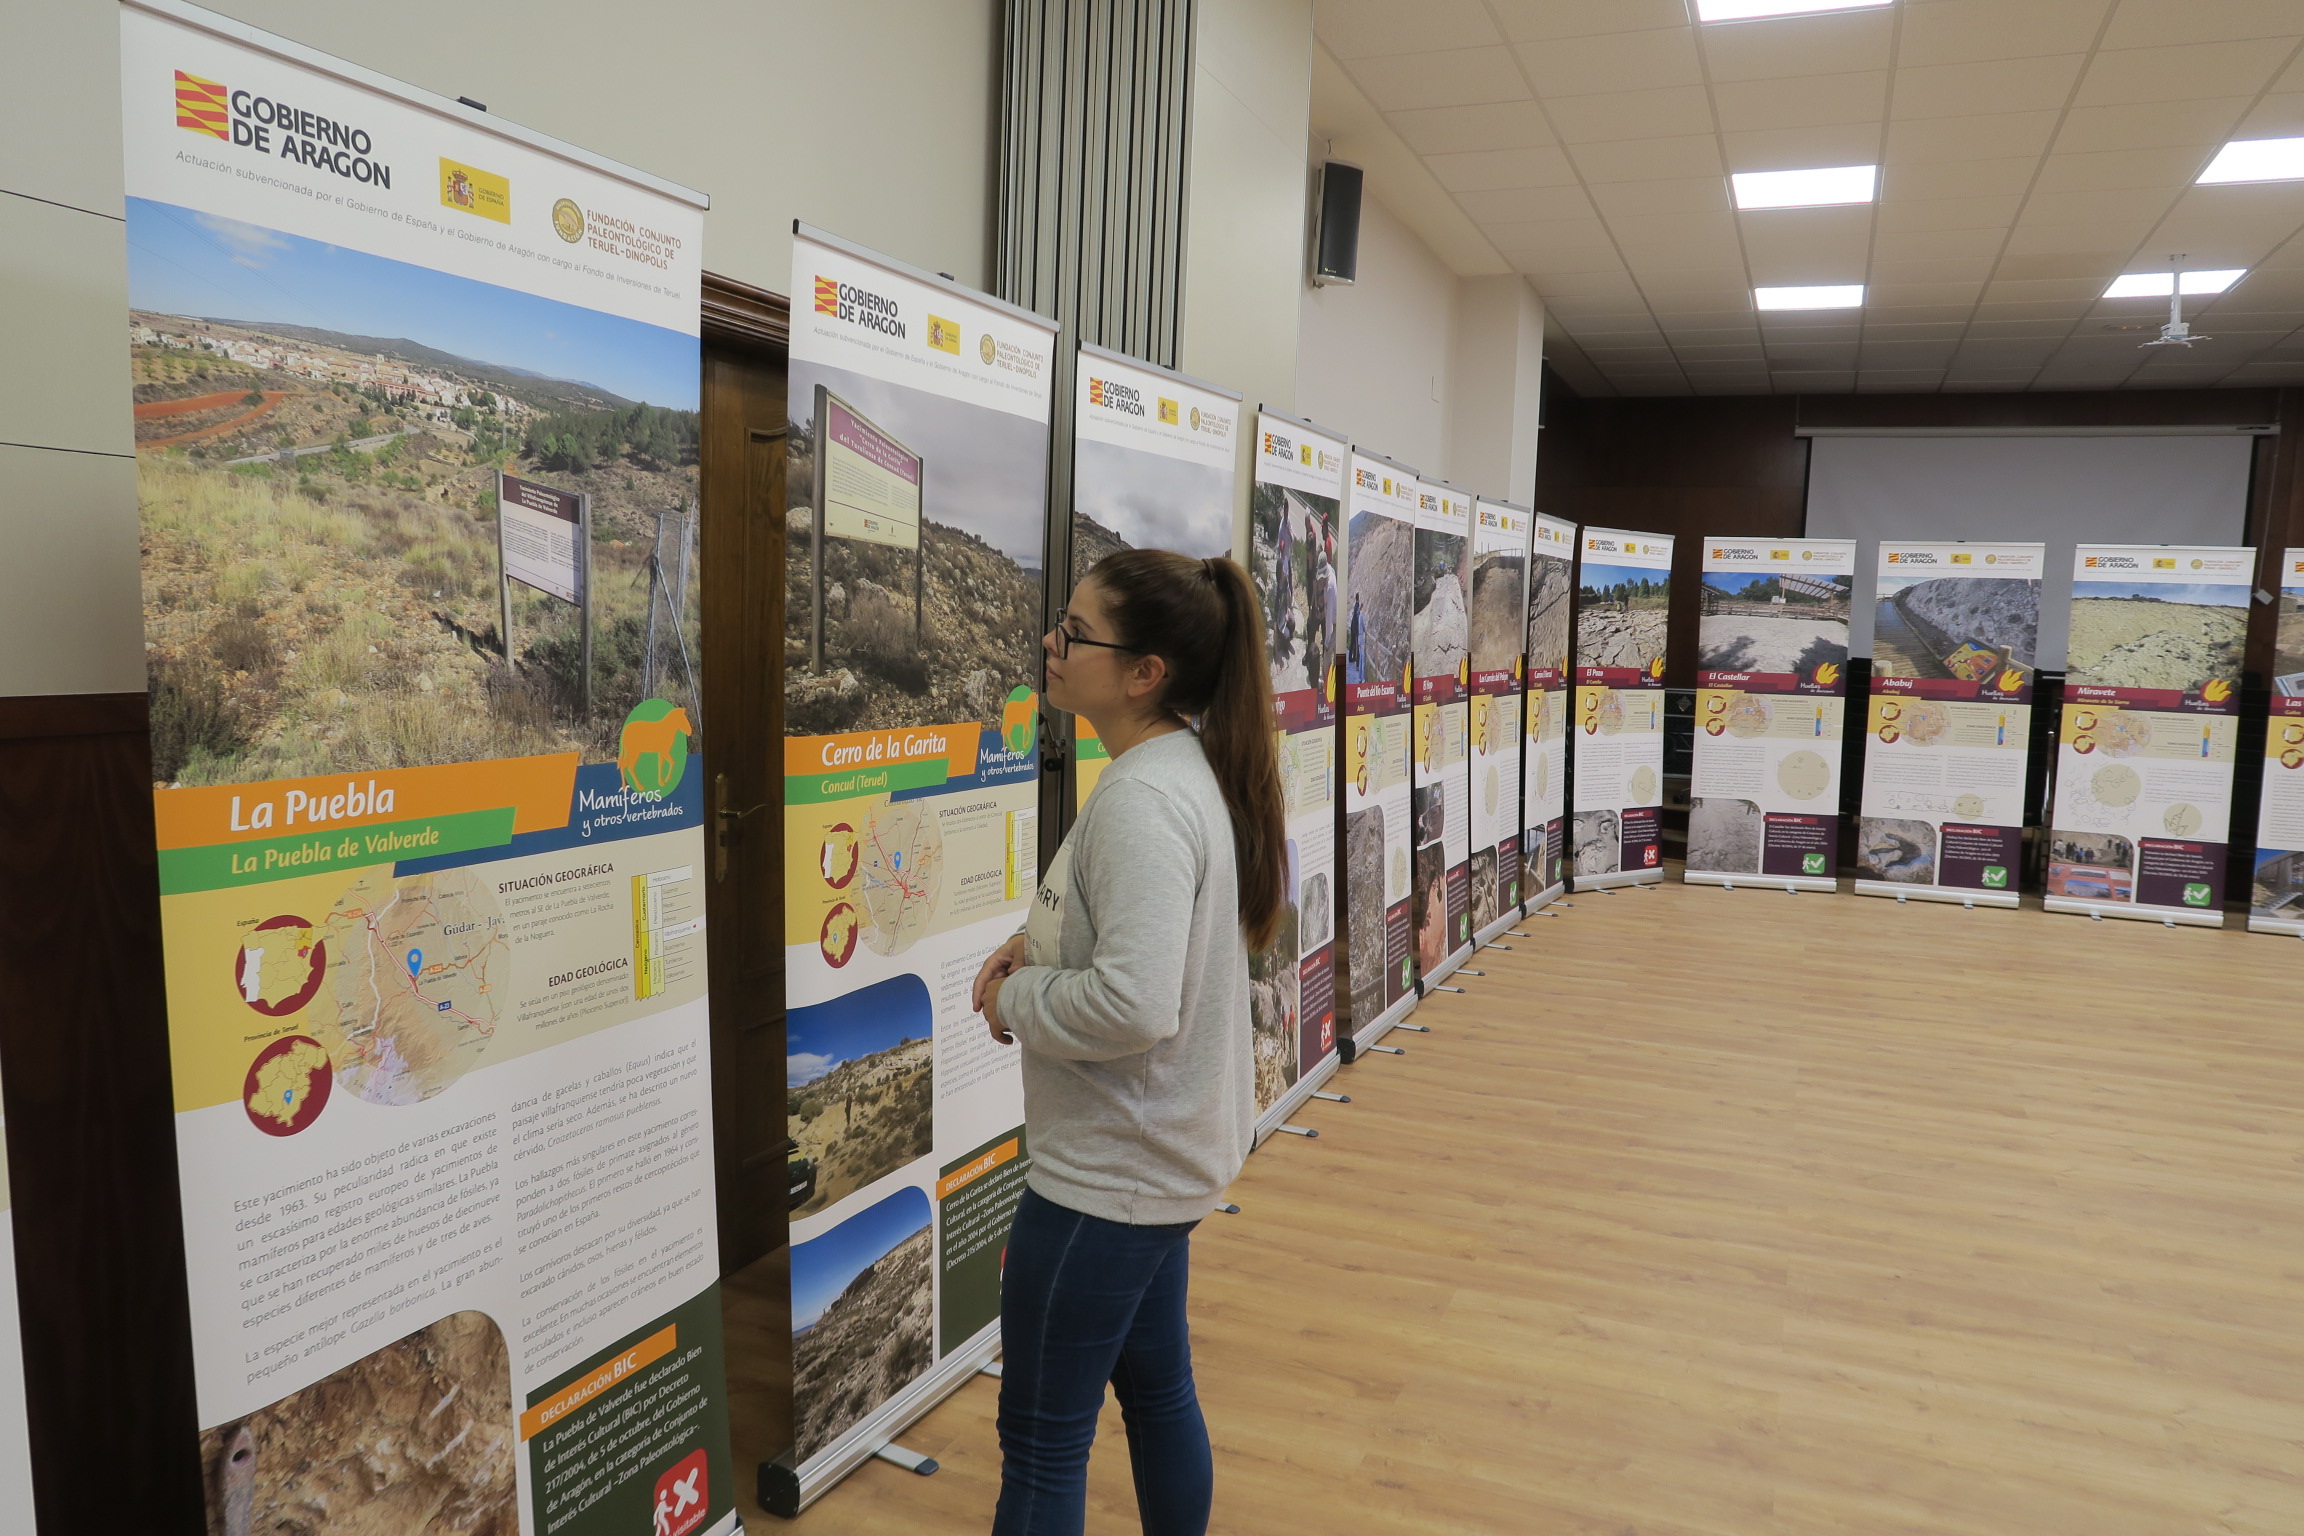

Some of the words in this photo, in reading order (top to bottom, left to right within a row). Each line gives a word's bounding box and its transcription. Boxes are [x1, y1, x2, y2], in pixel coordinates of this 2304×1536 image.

[231, 90, 372, 155] GOBIERNO
[232, 118, 270, 154] DE
[280, 134, 390, 190] ARAGON
[478, 187, 504, 200] GOBIERNO
[478, 192, 486, 201] DE
[485, 194, 504, 207] ESPAÑA
[175, 151, 232, 174] Actuación
[235, 168, 313, 197] subvencionada
[315, 191, 332, 202] por
[334, 196, 344, 205] el
[346, 198, 389, 218] Gobierno
[391, 211, 403, 222] de
[405, 214, 437, 231] España
[439, 226, 445, 235] y
[447, 228, 455, 236] el
[457, 229, 494, 247] Gobierno
[496, 241, 506, 251] de
[508, 244, 535, 258] Aragón
[536, 253, 550, 262] con
[551, 258, 572, 270] cargo
[582, 264, 604, 278] Fondo
[605, 272, 614, 280] de
[616, 274, 652, 291] Inversiones
[653, 286, 661, 294] de
[587, 209, 635, 234] FUNDACIÓN
[639, 226, 681, 249] CONJUNTO
[587, 222, 661, 255] PALEONTOLÓGICO
[664, 247, 674, 260] DE
[587, 236, 667, 270] TERUEL-DINÓPOLIS
[838, 283, 898, 317] GOBIERNO
[838, 302, 855, 323] DE
[858, 309, 906, 340] ARAGON
[1103, 381, 1140, 402] GOBIERNO
[1104, 396, 1114, 409] DE
[1115, 399, 1145, 417] ARAGON
[850, 418, 878, 443] Yacimiento
[878, 439, 911, 463] Paleontológico
[1272, 434, 1291, 449] GOBIERNO
[1272, 444, 1278, 456] DE
[1278, 446, 1294, 462] ARAGON
[839, 434, 850, 444] del
[850, 439, 876, 460] Turoliense
[877, 456, 883, 464] de
[883, 459, 899, 473] Concud
[899, 468, 914, 481] (Teruel)
[1362, 469, 1377, 482] GOBIERNO
[1366, 479, 1379, 491] ARAGON
[1595, 539, 1615, 547] GOBIERNO
[1592, 669, 1603, 677] Pozo
[1709, 672, 1717, 680] El
[1718, 672, 1750, 681] Castellar
[1882, 679, 1913, 689] Ababuj
[1801, 682, 1821, 690] Huellas
[2077, 687, 2116, 696] Miravete
[2185, 700, 2209, 708] Huellas
[2286, 699, 2302, 707] Las
[821, 743, 862, 766] Cerro
[865, 736, 883, 761] de
[886, 735, 900, 758] la
[904, 732, 946, 756] Garita
[980, 746, 1025, 771] Mamíferos
[821, 776, 855, 794] Concud
[856, 772, 887, 792] (Teruel)
[980, 769, 986, 782] y
[988, 766, 1002, 775] otros
[1003, 762, 1034, 773] vertebrados
[230, 797, 274, 831] La
[285, 781, 394, 825] Puebla
[579, 785, 662, 817] Mamíferos
[938, 805, 966, 818] SITUACIÓN
[966, 801, 997, 813] GEOGRÁFICA
[581, 819, 591, 837] y
[594, 811, 632, 827] otros
[631, 805, 683, 822] vertebrados
[231, 853, 258, 874] La
[264, 842, 332, 869] Puebla
[337, 838, 359, 858] de
[364, 827, 439, 853] Valverde
[498, 874, 553, 894] SITUACIÓN
[554, 863, 614, 883] GEOGRÁFICA
[960, 875, 974, 886] EDAD
[974, 869, 1002, 882] GEOLÓGICA
[444, 921, 475, 936] Gúdar
[548, 971, 574, 987] EDAD
[575, 958, 628, 979] GEOLÓGICA
[244, 1031, 272, 1042] Provincia
[282, 1023, 299, 1033] Teruel
[945, 1164, 983, 1191] DECLARACIÓN
[983, 1153, 995, 1169] BIC
[540, 1372, 612, 1424] DECLARACIÓN
[613, 1351, 637, 1378] BIC
[543, 1439, 554, 1453] La
[555, 1419, 585, 1445] Puebla
[585, 1411, 597, 1425] de
[597, 1388, 633, 1416] Valverde
[633, 1380, 647, 1395] fue
[648, 1356, 686, 1385] declarado
[686, 1346, 702, 1362] Bien
[544, 1459, 556, 1473] de
[557, 1439, 587, 1465] Interés
[587, 1414, 621, 1444] Cultural
[621, 1401, 642, 1424] (BIC)
[643, 1392, 658, 1411] por
[658, 1373, 689, 1399] Decreto
[545, 1459, 586, 1494] 217/2004,
[587, 1451, 599, 1465] de
[599, 1444, 606, 1457] 5
[606, 1438, 618, 1452] de
[618, 1417, 652, 1444] octubre,
[652, 1404, 665, 1421] del
[665, 1384, 700, 1412] Gobierno
